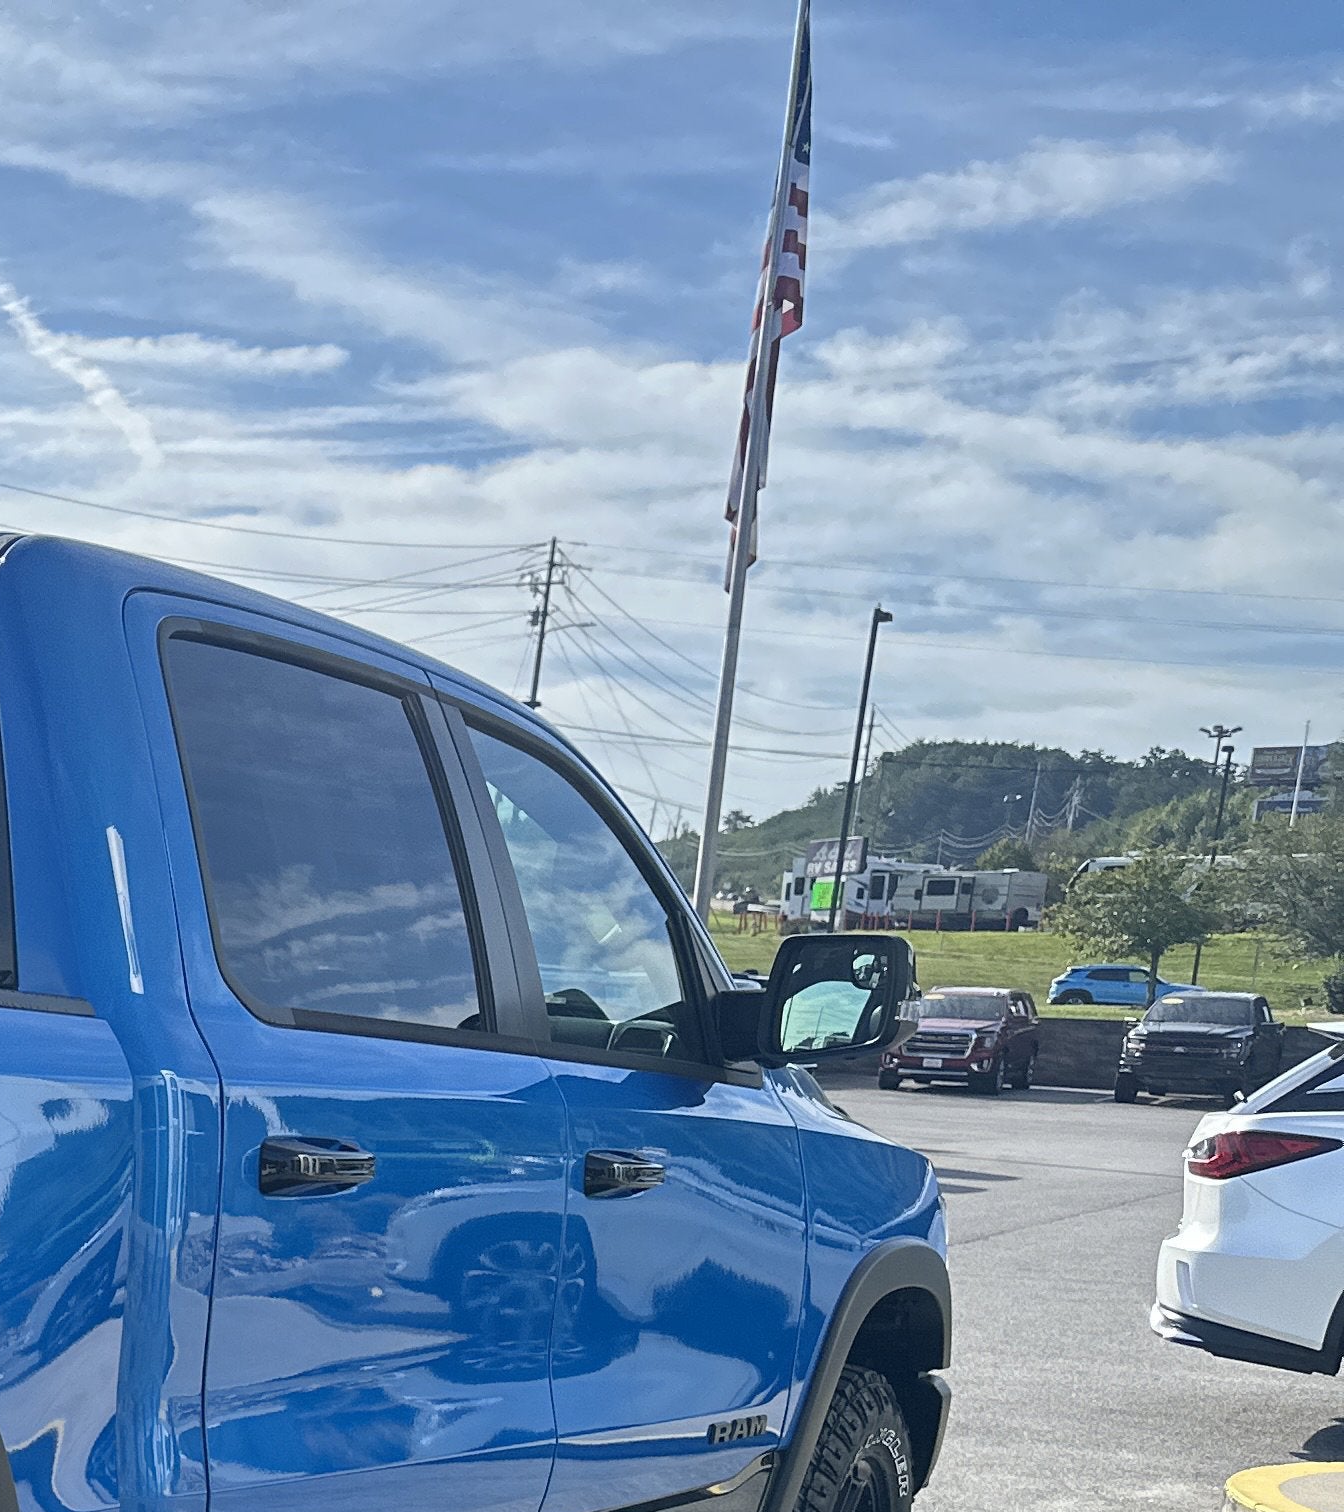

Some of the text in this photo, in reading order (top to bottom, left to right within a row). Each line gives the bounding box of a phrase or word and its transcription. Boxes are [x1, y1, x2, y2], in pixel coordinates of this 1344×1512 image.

[806, 859, 857, 875] RV SAES
[707, 1414, 768, 1445] RAM
